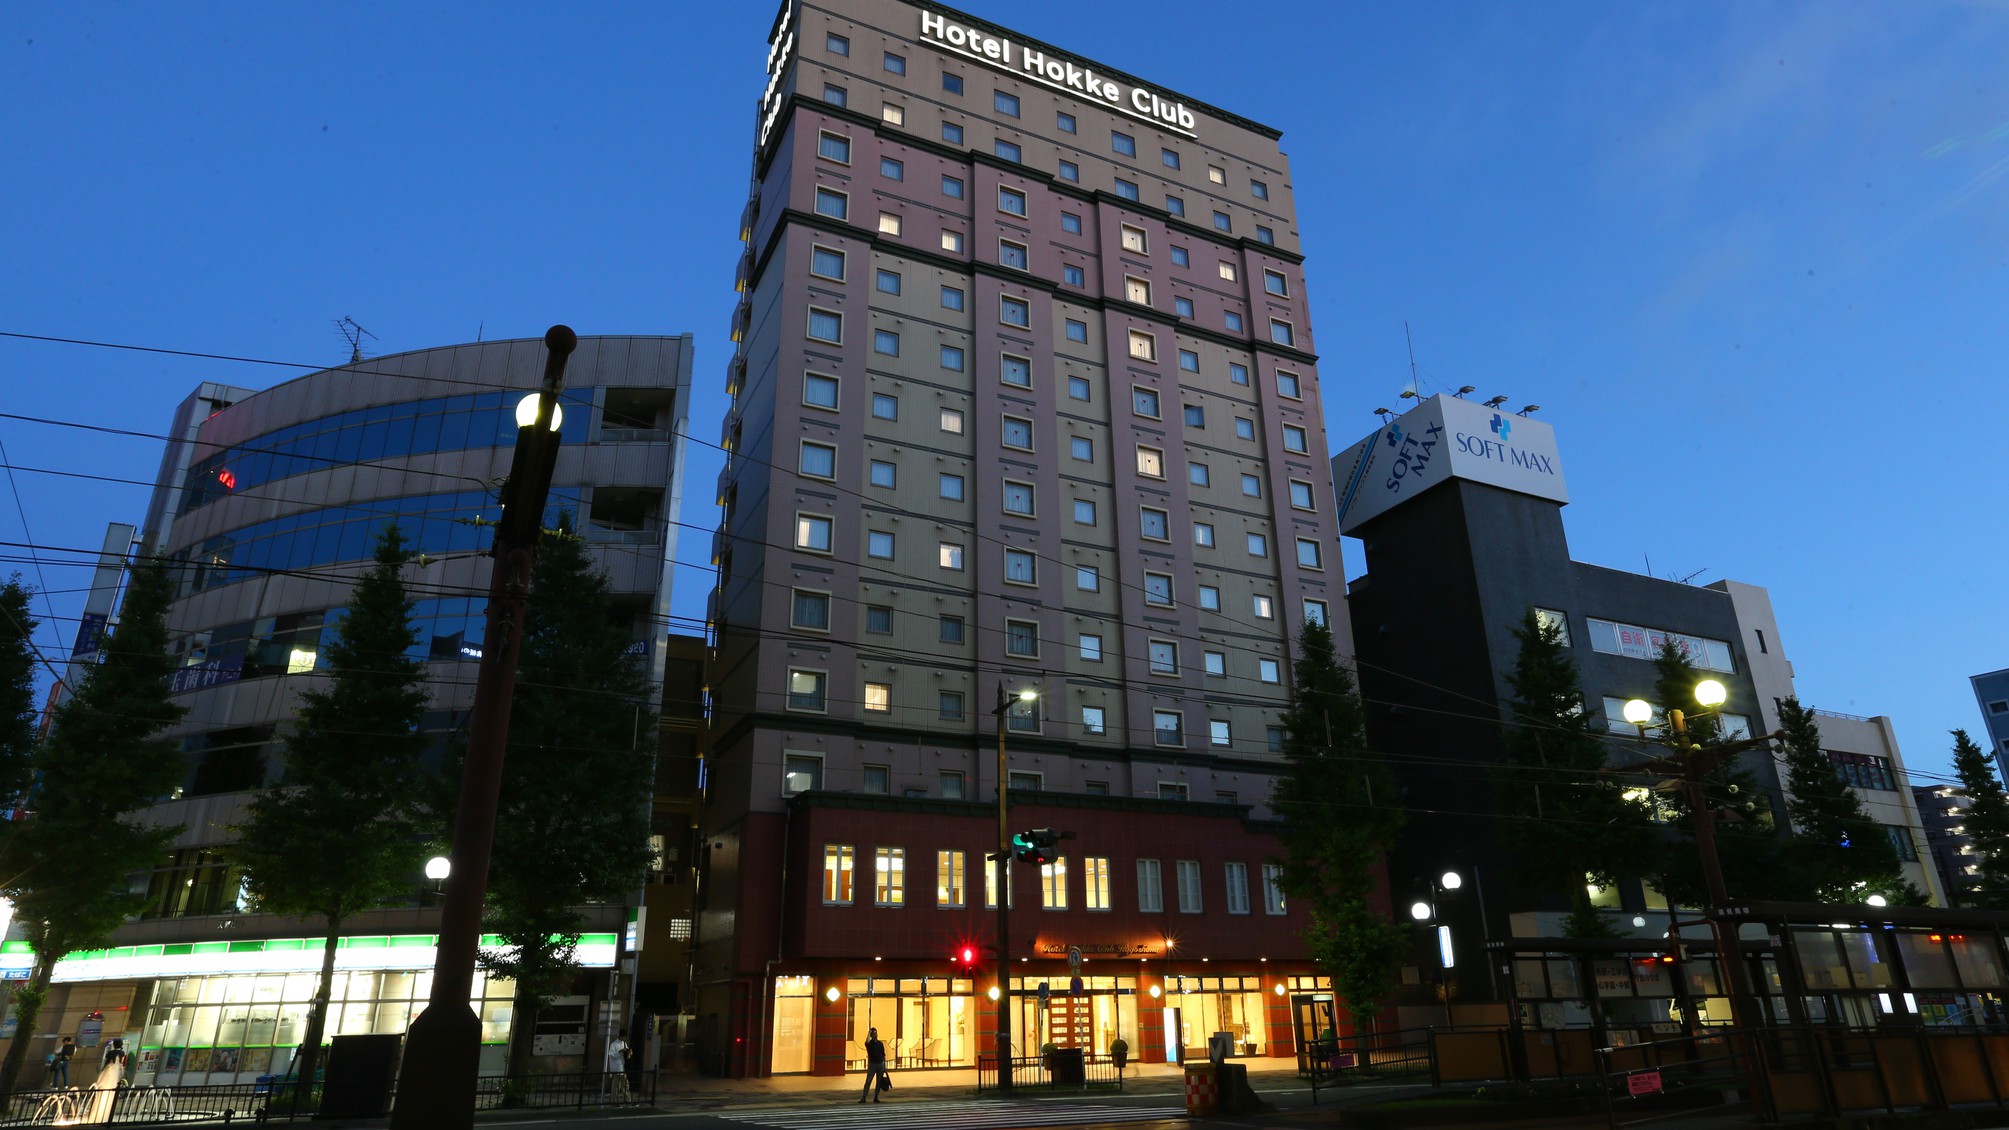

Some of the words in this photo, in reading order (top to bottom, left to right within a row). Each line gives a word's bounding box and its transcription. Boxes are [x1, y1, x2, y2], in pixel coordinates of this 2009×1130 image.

[767, 0, 793, 74] Hotel
[764, 32, 793, 112] Hokke
[921, 10, 1010, 63] Hotel
[1024, 46, 1120, 102] Hokke
[1131, 87, 1196, 130] Club
[761, 92, 782, 147] Club
[1386, 432, 1419, 494] SOFT
[1411, 421, 1443, 477] MAX
[1456, 432, 1505, 463] SOFT
[1511, 447, 1554, 475] MAX
[1042, 944, 1065, 953] Hotel
